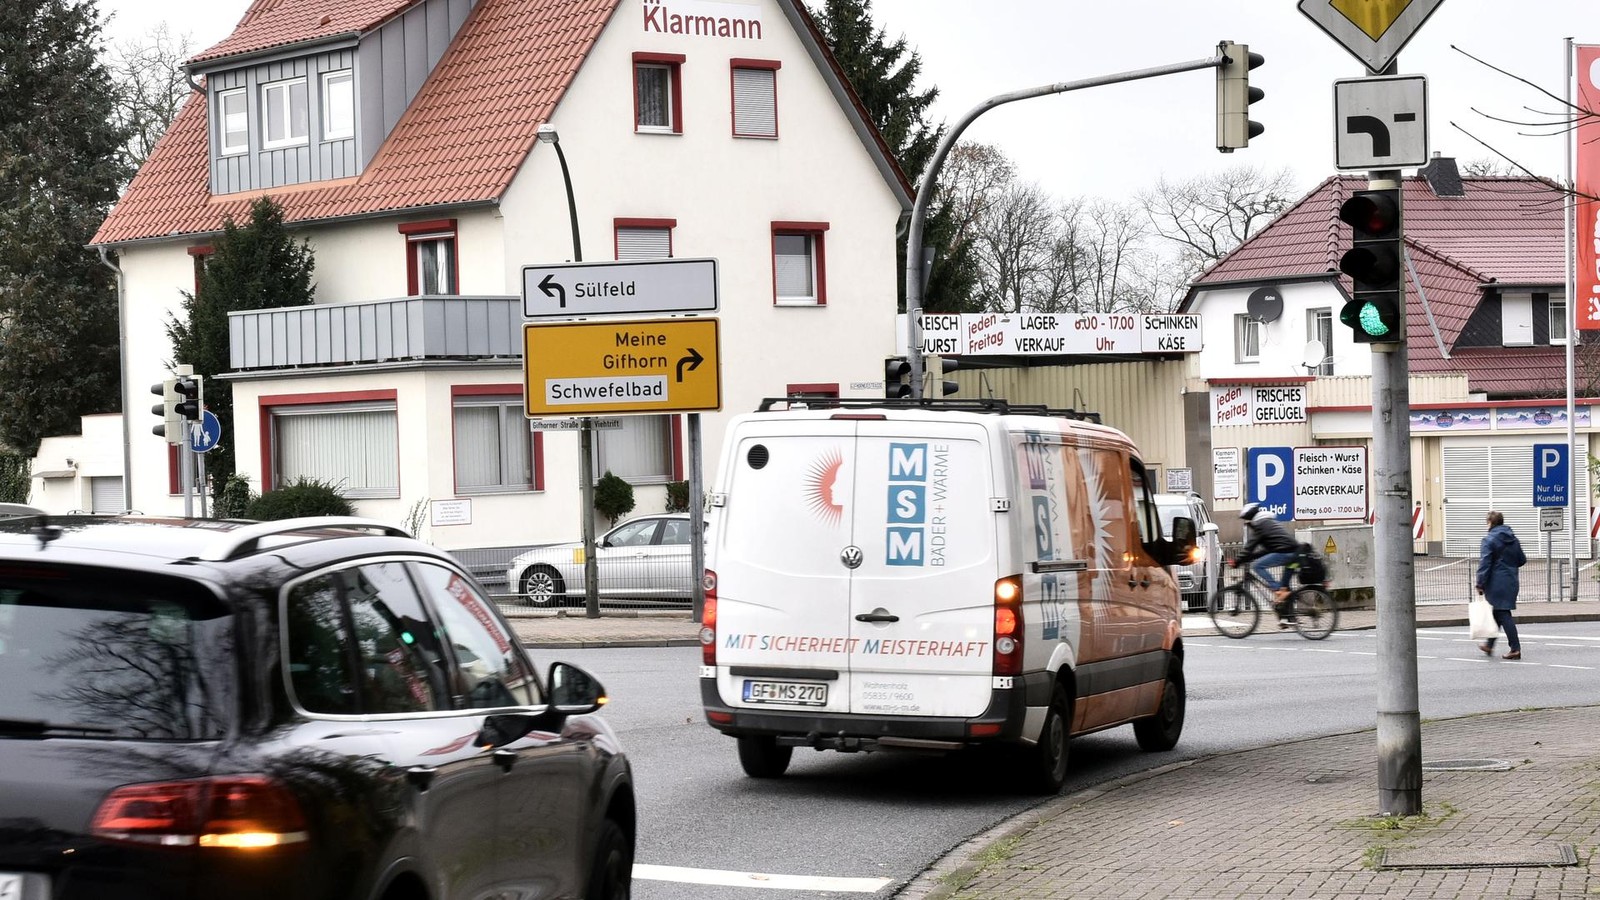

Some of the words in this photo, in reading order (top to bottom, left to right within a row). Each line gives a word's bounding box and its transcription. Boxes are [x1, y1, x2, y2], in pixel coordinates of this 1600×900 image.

[643, 5, 762, 40] Klarmann
[574, 281, 636, 298] Sülfeld
[922, 316, 958, 331] EISCH
[968, 314, 996, 339] jeden
[1020, 316, 1059, 330] LAGER-
[1108, 316, 1135, 330] 17.00
[1145, 316, 1198, 330] SCHINKEN
[615, 332, 667, 347] Meine
[969, 331, 1004, 354] Freitag
[1015, 338, 1065, 352] VERKAUF
[1096, 336, 1115, 351] Uhr
[1158, 333, 1186, 350] KÄSE
[603, 354, 668, 370] Gifhorn
[551, 381, 662, 399] Schwefelbad
[1256, 388, 1301, 403] FRISCHES
[1216, 387, 1242, 411] jeden
[1217, 402, 1248, 424] Freitag
[1255, 404, 1304, 421] GEFLÜGEL
[594, 420, 619, 428] Viehtrift
[1299, 453, 1328, 462] Fleisch
[1334, 453, 1359, 462] Wurst
[1541, 449, 1560, 479] P
[1297, 465, 1335, 475] Schinken
[1341, 465, 1362, 474] Käse
[1256, 454, 1285, 502] P
[1296, 485, 1364, 496] LAGERVERKAUF
[1553, 484, 1564, 492] für
[1537, 494, 1564, 502] Kunden
[1270, 503, 1287, 515] Hof
[1296, 507, 1317, 515] Freitag
[1318, 506, 1332, 514] 6.00
[725, 634, 757, 649] MIT
[760, 635, 859, 654] SICHERHEIT
[863, 639, 988, 658] MEISTERHAFT
[752, 684, 770, 698] GF
[778, 685, 796, 699] MS
[798, 686, 824, 701] 270
